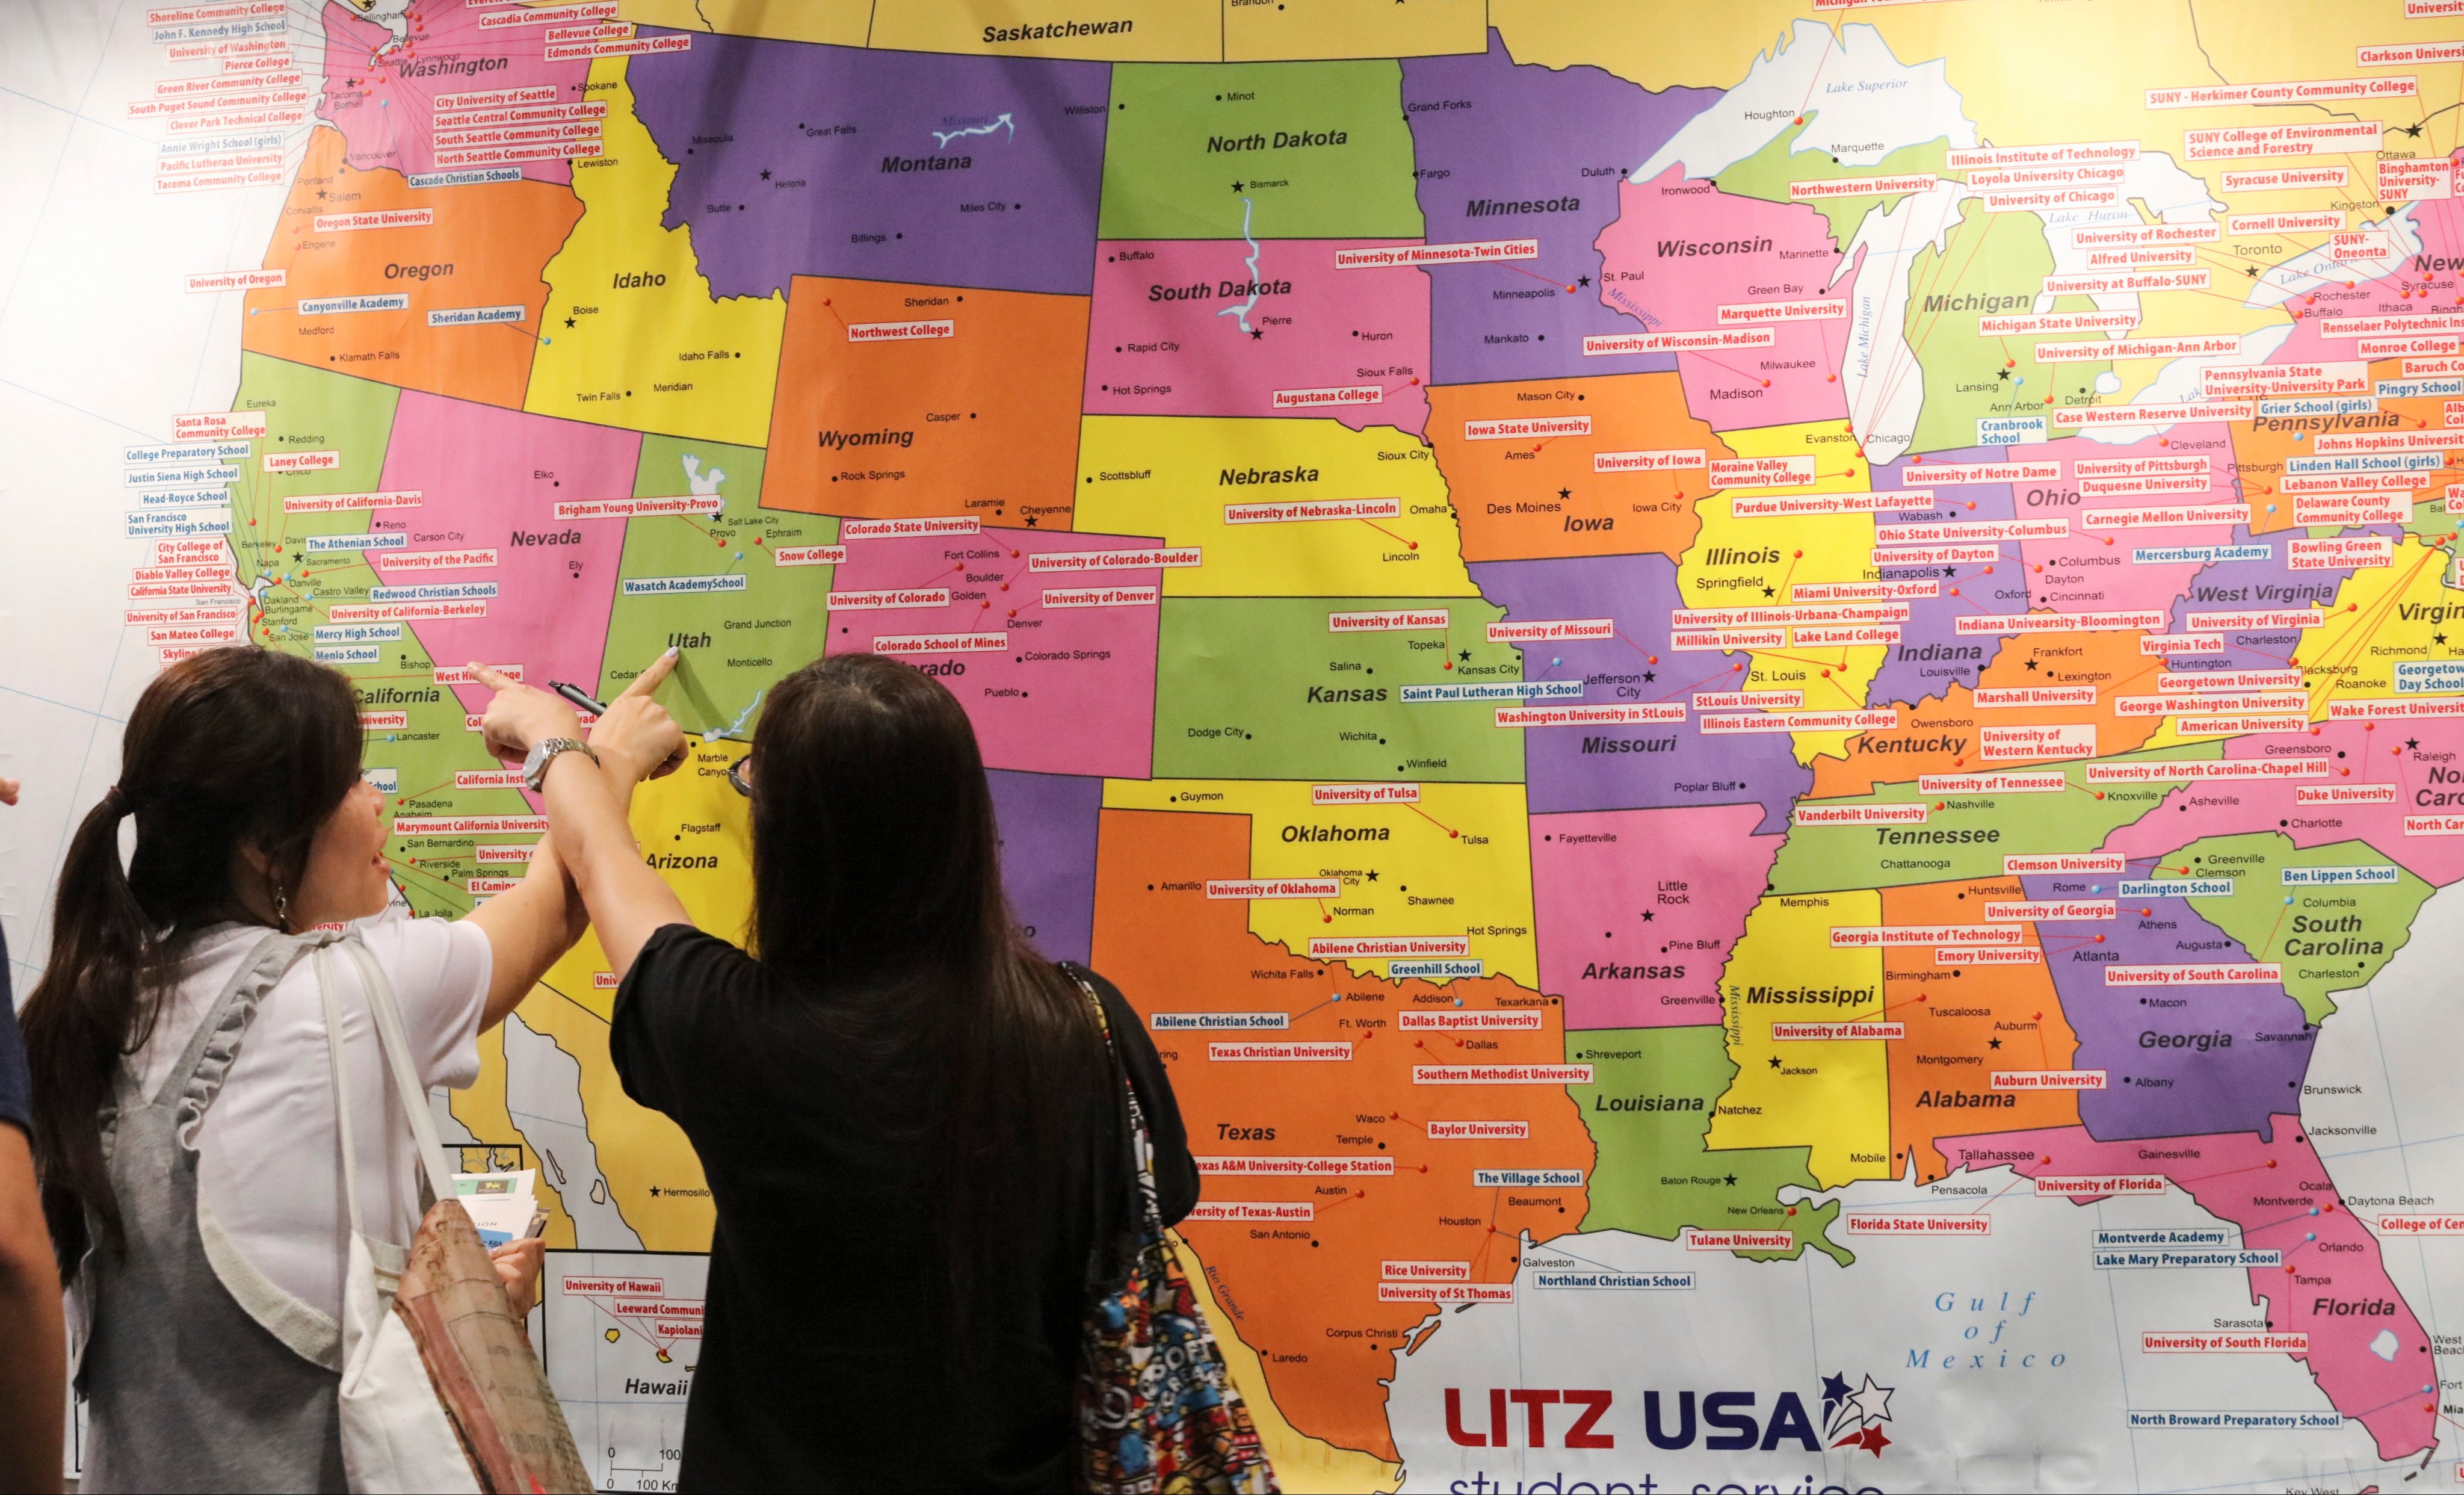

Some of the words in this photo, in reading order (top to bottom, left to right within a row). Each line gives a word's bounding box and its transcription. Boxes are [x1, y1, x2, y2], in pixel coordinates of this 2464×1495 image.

[155, 30, 176, 40] John
[179, 29, 187, 38] F.
[189, 25, 229, 37] Kennedy
[232, 23, 253, 36] High
[255, 20, 285, 32] School
[549, 29, 590, 40] Bellevue
[593, 25, 628, 37] College
[983, 20, 1132, 43] Saskatchewan
[397, 56, 508, 78] Washington
[1826, 82, 1854, 93] Lake
[1857, 79, 1908, 93] Superior
[436, 98, 454, 108] City
[457, 94, 505, 106] University
[508, 91, 518, 101] of
[520, 89, 555, 101] Seattle
[1745, 110, 1794, 120] Houghton
[1207, 134, 1265, 153] North
[1273, 130, 1347, 149] Dakota
[1952, 153, 1993, 166] Illinois
[1996, 151, 2048, 163] Institute
[2052, 149, 2064, 160] of
[2066, 147, 2135, 159] Technology
[2376, 150, 2417, 161] Ottawa
[882, 156, 972, 173] Montana
[1581, 167, 1615, 177] Duluth
[1250, 179, 1289, 188] Bismarck
[1466, 196, 1579, 217] Minnesota
[317, 219, 350, 229] Oregon
[353, 216, 379, 225] State
[381, 211, 431, 223] University
[1658, 239, 1772, 258] Wisconsin
[2232, 244, 2282, 255] Toronto
[384, 263, 454, 281] Oregon
[613, 271, 666, 289] Idaho
[1148, 282, 1211, 302] South
[1218, 279, 1291, 298] Dakota
[1493, 288, 1555, 300] Minneapolis
[1748, 286, 1780, 295] Green
[1783, 284, 1803, 294] Bay
[302, 300, 357, 313] Canyonville
[360, 297, 404, 308] Academy
[573, 306, 599, 315] Boise
[1924, 294, 2029, 315] Michigan
[432, 312, 475, 323] Sheridan
[477, 310, 520, 321] Academy
[1858, 296, 1873, 348] Michigan
[2361, 343, 2407, 353] Monroe
[2410, 340, 2456, 352] College
[1857, 352, 1868, 377] Lake
[1276, 392, 1335, 406] Augustana
[1338, 389, 1379, 402] College
[1710, 388, 1762, 400] Madison
[2261, 403, 2291, 414] Grier
[2294, 401, 2333, 413] School
[2336, 400, 2371, 413] (girls)
[926, 413, 960, 422] Casper
[2253, 413, 2400, 433] Pennsylvania
[819, 431, 913, 450] Wyoming
[2171, 439, 2226, 450] Cleveland
[127, 450, 159, 460] College
[161, 448, 215, 459] Preparatory
[218, 445, 248, 456] School
[270, 458, 297, 468] Laney
[299, 455, 333, 466] College
[1711, 462, 1754, 472] Moraine
[1756, 460, 1788, 472] Valley
[1100, 470, 1151, 481] Scottsbluff
[1219, 466, 1319, 486] Nebraska
[1711, 473, 1771, 485] Community
[1773, 472, 1811, 484] College
[2027, 489, 2081, 507] Ohio
[559, 504, 601, 516] Brigham
[603, 503, 634, 514] Young
[636, 500, 718, 512] University-Provo
[1487, 503, 1511, 514] Des
[1516, 503, 1561, 513] Moines
[1564, 515, 1613, 532] Iowa
[511, 529, 581, 546] Nevada
[1706, 548, 1780, 565] Illinois
[2136, 548, 2211, 560] Mercersburg
[2214, 547, 2268, 559] Academy
[1697, 577, 1763, 590] Springfield
[1045, 592, 1100, 604] University
[1102, 592, 1114, 602] of
[1116, 591, 1154, 601] Denver
[2198, 587, 2249, 602] West
[2256, 585, 2333, 604] Virginia
[1898, 644, 1982, 661] Indiana
[2143, 640, 2190, 652] Virginia
[2194, 639, 2221, 649] Tech
[1749, 670, 1767, 681] St.
[1773, 670, 1806, 681] Louis
[984, 688, 1019, 697] Pueblo
[1308, 687, 1387, 703] Kansas
[1403, 689, 1432, 699] Saint
[1436, 687, 1459, 698] Paul
[1463, 687, 1513, 698] Lutheran
[1517, 685, 1543, 698] High
[1546, 684, 1581, 695] School
[397, 732, 440, 741] Lancaster
[1339, 732, 1377, 741] Wichita
[1858, 735, 1967, 756] Kentucky
[2298, 790, 2328, 800] Duke
[2332, 788, 2394, 800] University
[2291, 819, 2342, 828] Charlotte
[1282, 825, 1389, 843] Oklahoma
[1877, 828, 1999, 845] Tennessee
[646, 853, 718, 869] Arizona
[2284, 871, 2308, 881] Ben
[2311, 870, 2352, 883] Lippen
[2356, 868, 2395, 879] School
[1658, 881, 1688, 891] Little
[1408, 896, 1454, 905] Shawnee
[1658, 894, 1690, 905] Rock
[2292, 915, 2362, 933] South
[2285, 938, 2383, 956] Carolina
[1581, 962, 1685, 979] Arkansas
[1747, 986, 1874, 1007] Mississippi
[2149, 998, 2187, 1008] Macon
[1155, 1017, 1196, 1027] Abilene
[1199, 1016, 1247, 1026] Christian
[1250, 1015, 1283, 1026] School
[1729, 985, 1744, 1046] Mississippi
[1775, 1026, 1833, 1038] University
[1836, 1026, 1848, 1036] of
[1850, 1026, 1901, 1036] Alabama
[2139, 1030, 2232, 1051] Georgia
[1596, 1095, 1704, 1112] Louisiana
[1916, 1091, 2016, 1107] Alabama
[1217, 1124, 1275, 1141] Texas
[1691, 1177, 1721, 1186] Rouge
[664, 1188, 710, 1196] Hermosillo
[1439, 1217, 1481, 1226] Houston
[1690, 1235, 1731, 1245] Tulane
[1733, 1234, 1791, 1246] University
[2096, 1254, 2125, 1265] Lake
[2129, 1254, 2158, 1266] Mary
[2162, 1254, 2236, 1266] Preparatory
[2239, 1252, 2278, 1263] School
[566, 1280, 614, 1293] University
[616, 1281, 626, 1291] of
[629, 1281, 661, 1292] Hawaii
[1935, 1292, 2036, 1316] Gulf
[2313, 1298, 2395, 1316] Florida
[1326, 1328, 1363, 1339] Corpus
[1366, 1329, 1398, 1338] Christi
[1964, 1320, 2007, 1344] of
[2145, 1337, 2207, 1349] University
[2210, 1337, 2223, 1348] of
[2226, 1337, 2261, 1348] South
[2265, 1337, 2306, 1348] Florida
[1905, 1349, 2066, 1369] Mexico
[625, 1379, 687, 1395] Hawaii
[1445, 1388, 1614, 1449] LITZ
[1644, 1391, 1821, 1452] USA
